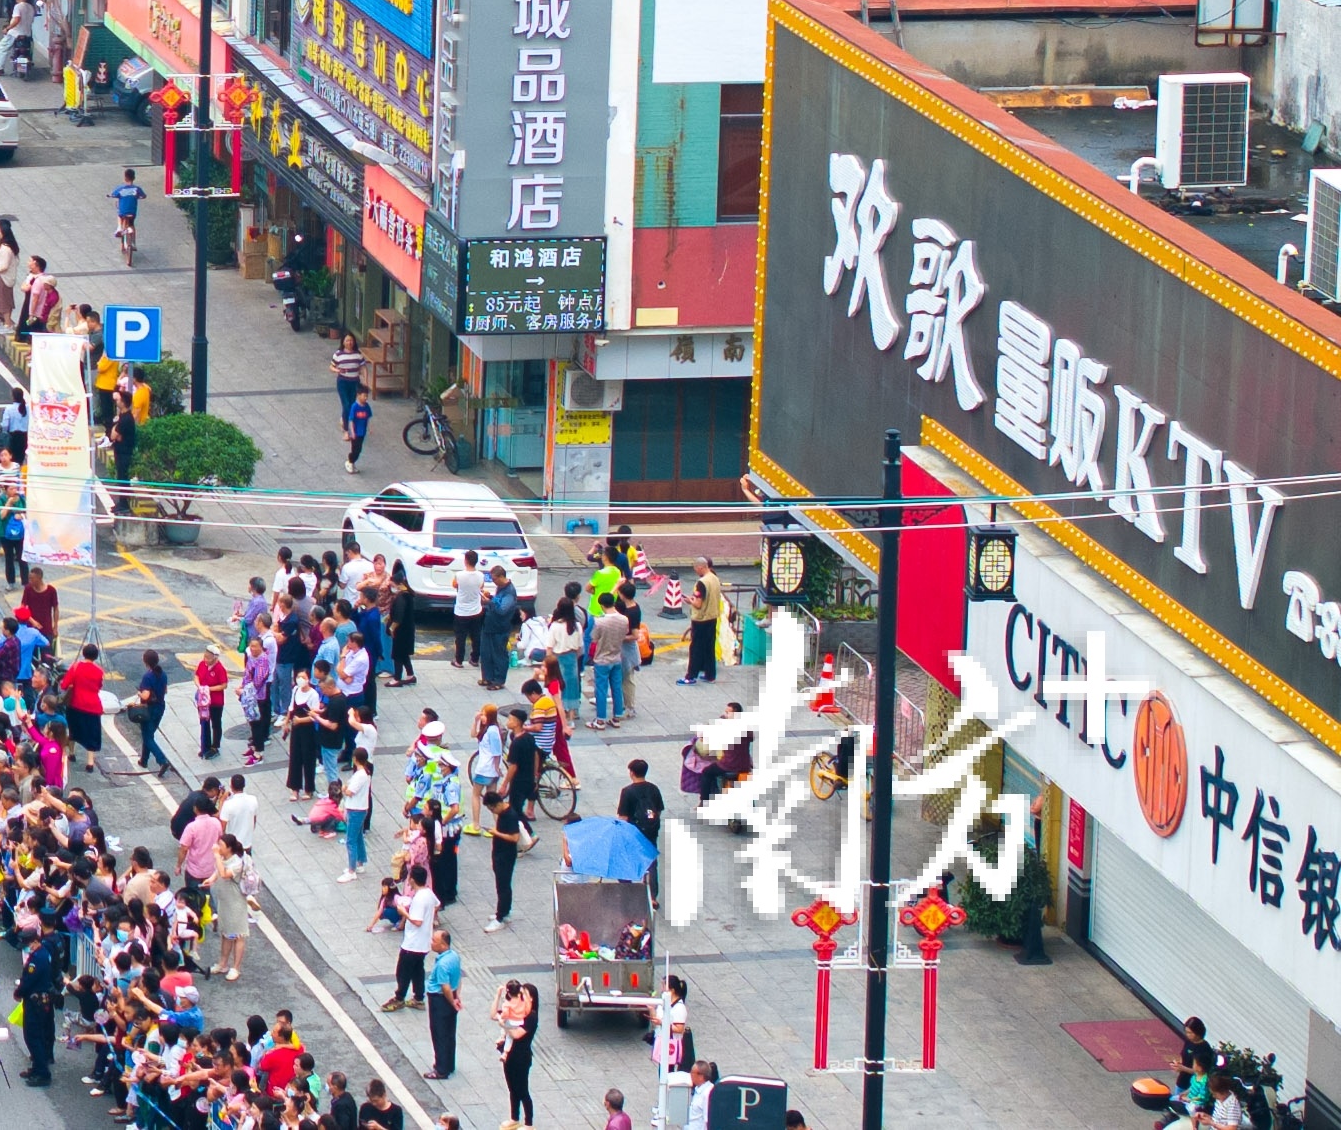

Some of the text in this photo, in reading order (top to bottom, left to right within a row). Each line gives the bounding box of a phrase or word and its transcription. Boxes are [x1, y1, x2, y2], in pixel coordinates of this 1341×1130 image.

[489, 246, 583, 269] 和鸿酒店
[486, 295, 541, 313] 85元起
[115, 310, 150, 358] P
[823, 152, 1284, 610] 欢歌 量贩KTV
[1199, 745, 1341, 951] 中信银
[738, 1086, 761, 1121] P
